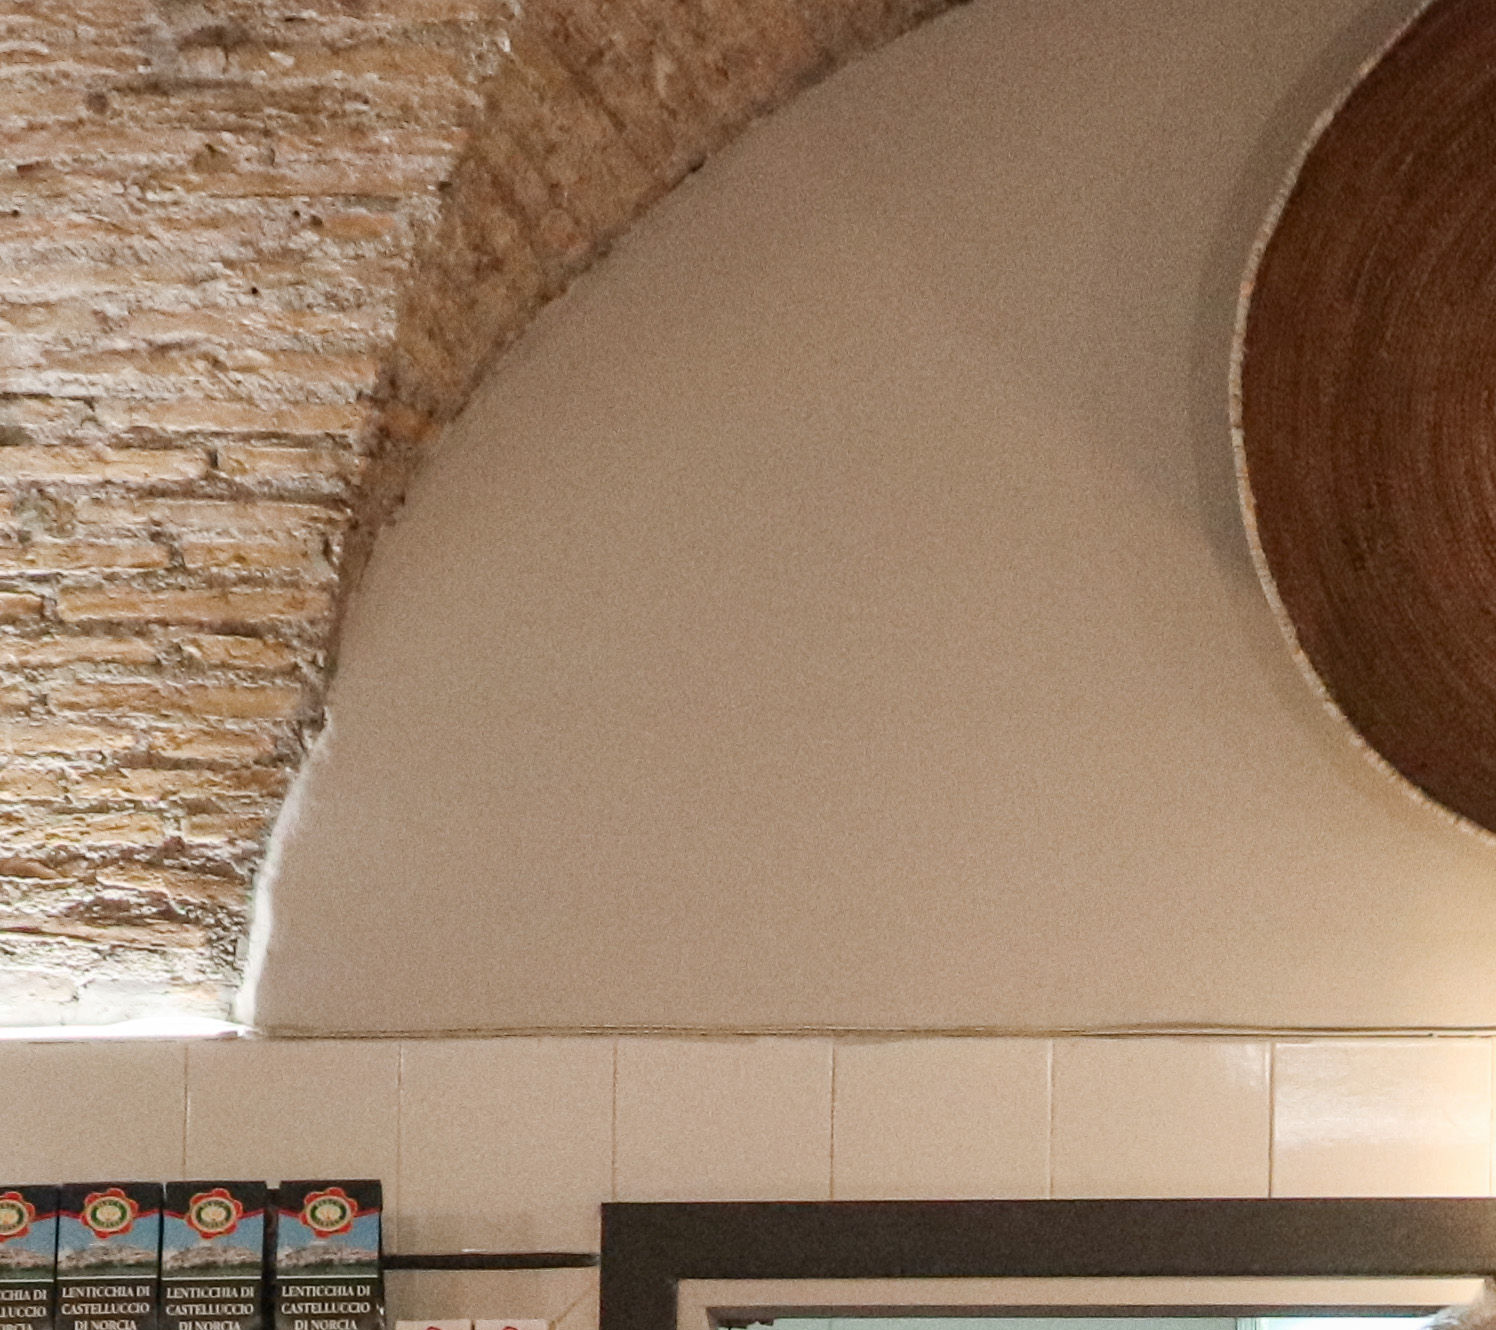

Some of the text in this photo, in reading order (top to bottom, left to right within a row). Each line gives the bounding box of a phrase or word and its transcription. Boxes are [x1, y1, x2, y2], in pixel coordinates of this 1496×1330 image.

[33, 1288, 47, 1301] DI
[62, 1285, 150, 1298] LENTICCHIA DI
[166, 1286, 254, 1299] LENTICCHIA DI
[281, 1284, 370, 1298] LENTICCHIA DI
[61, 1302, 150, 1316] CASTELLUCCIO
[166, 1303, 255, 1316] CASTELLUCCIO
[281, 1301, 371, 1315] CASTELLUCCIO
[294, 1319, 358, 1330] DI NORCIA
